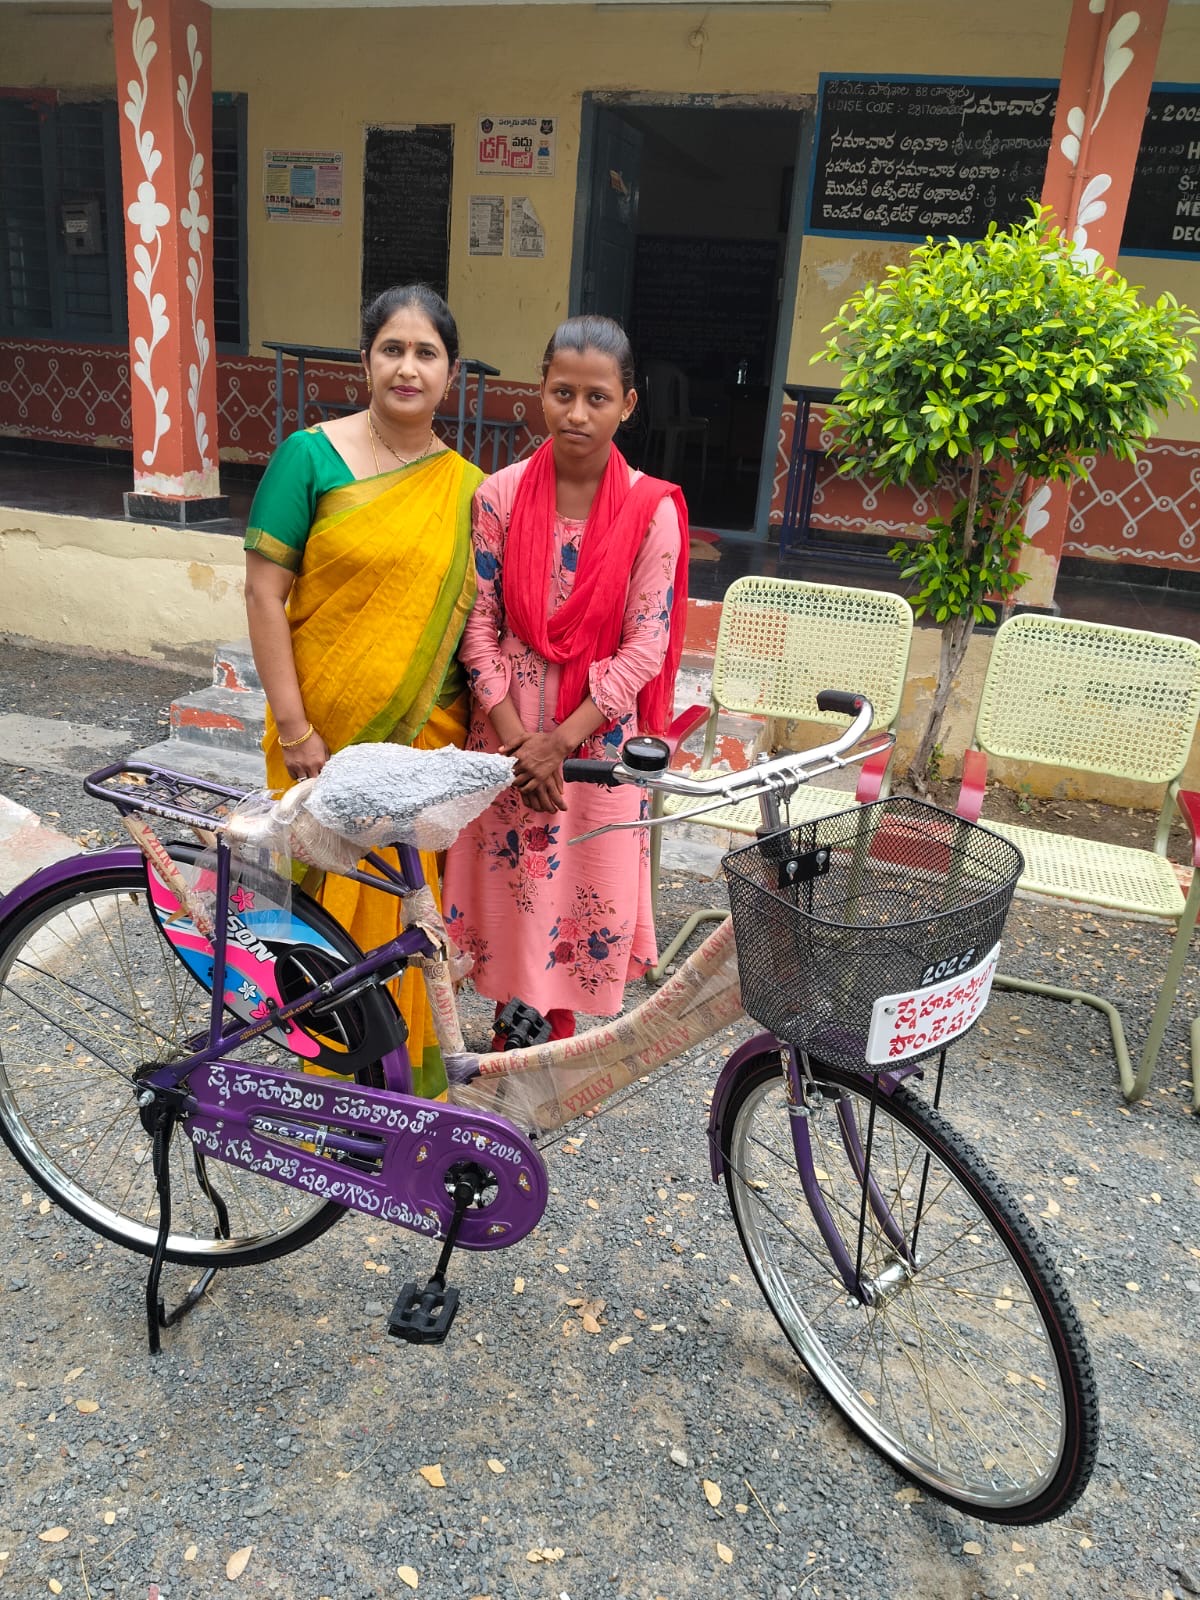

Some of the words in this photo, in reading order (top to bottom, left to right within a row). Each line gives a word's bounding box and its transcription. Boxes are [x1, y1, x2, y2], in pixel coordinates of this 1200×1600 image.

[866, 102, 895, 113] CODE
[830, 125, 897, 152] సమాచార
[921, 948, 976, 985] 2026
[564, 1030, 617, 1059] ANIKA
[562, 1073, 615, 1112] ANIKA
